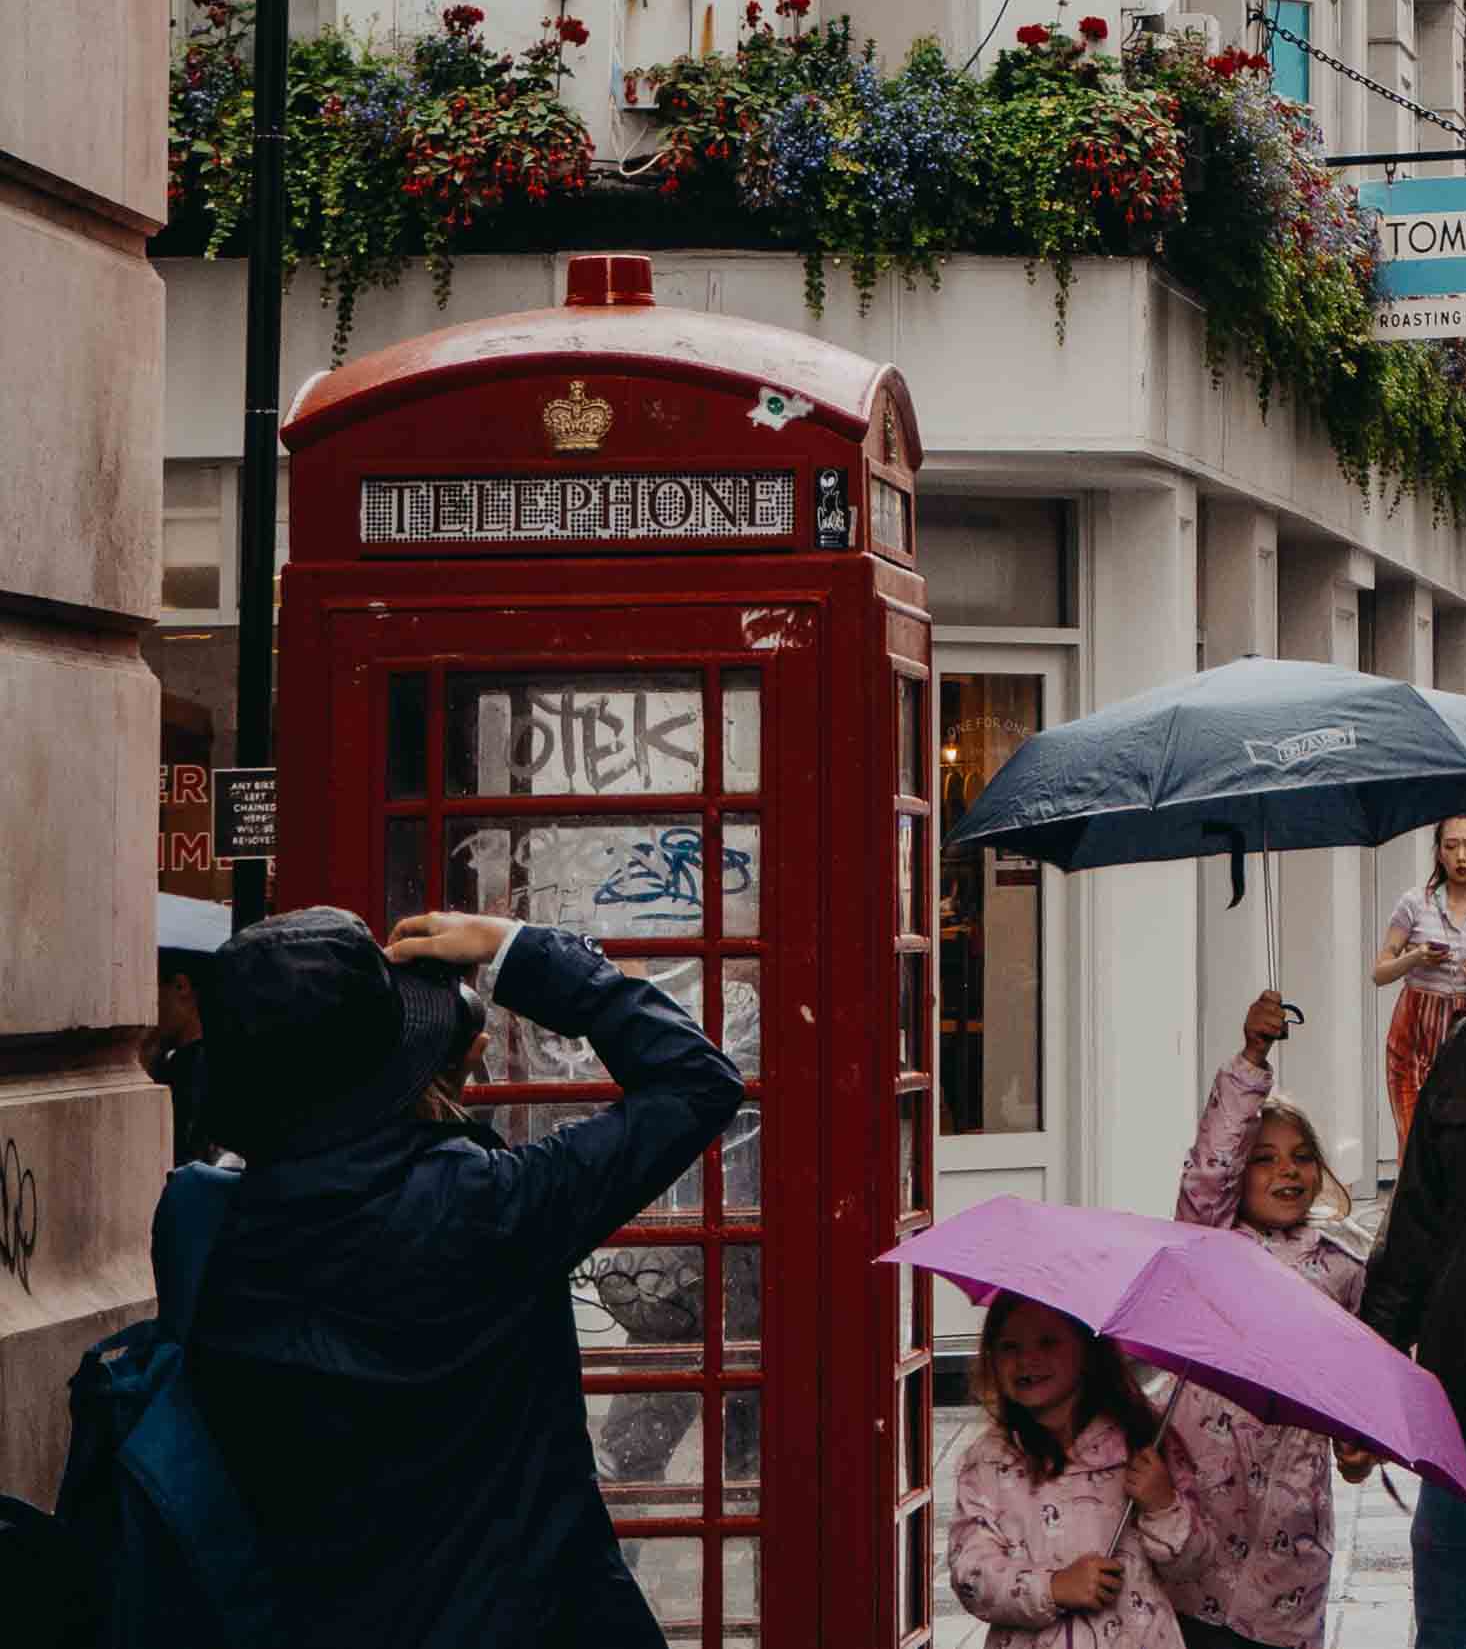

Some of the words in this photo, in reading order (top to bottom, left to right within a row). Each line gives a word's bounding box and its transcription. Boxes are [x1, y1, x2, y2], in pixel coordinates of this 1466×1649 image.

[1380, 311, 1462, 328] ROASTING
[383, 475, 779, 535] TELEPHONE
[977, 717, 1000, 728] FOR
[244, 792, 266, 801] LEFT
